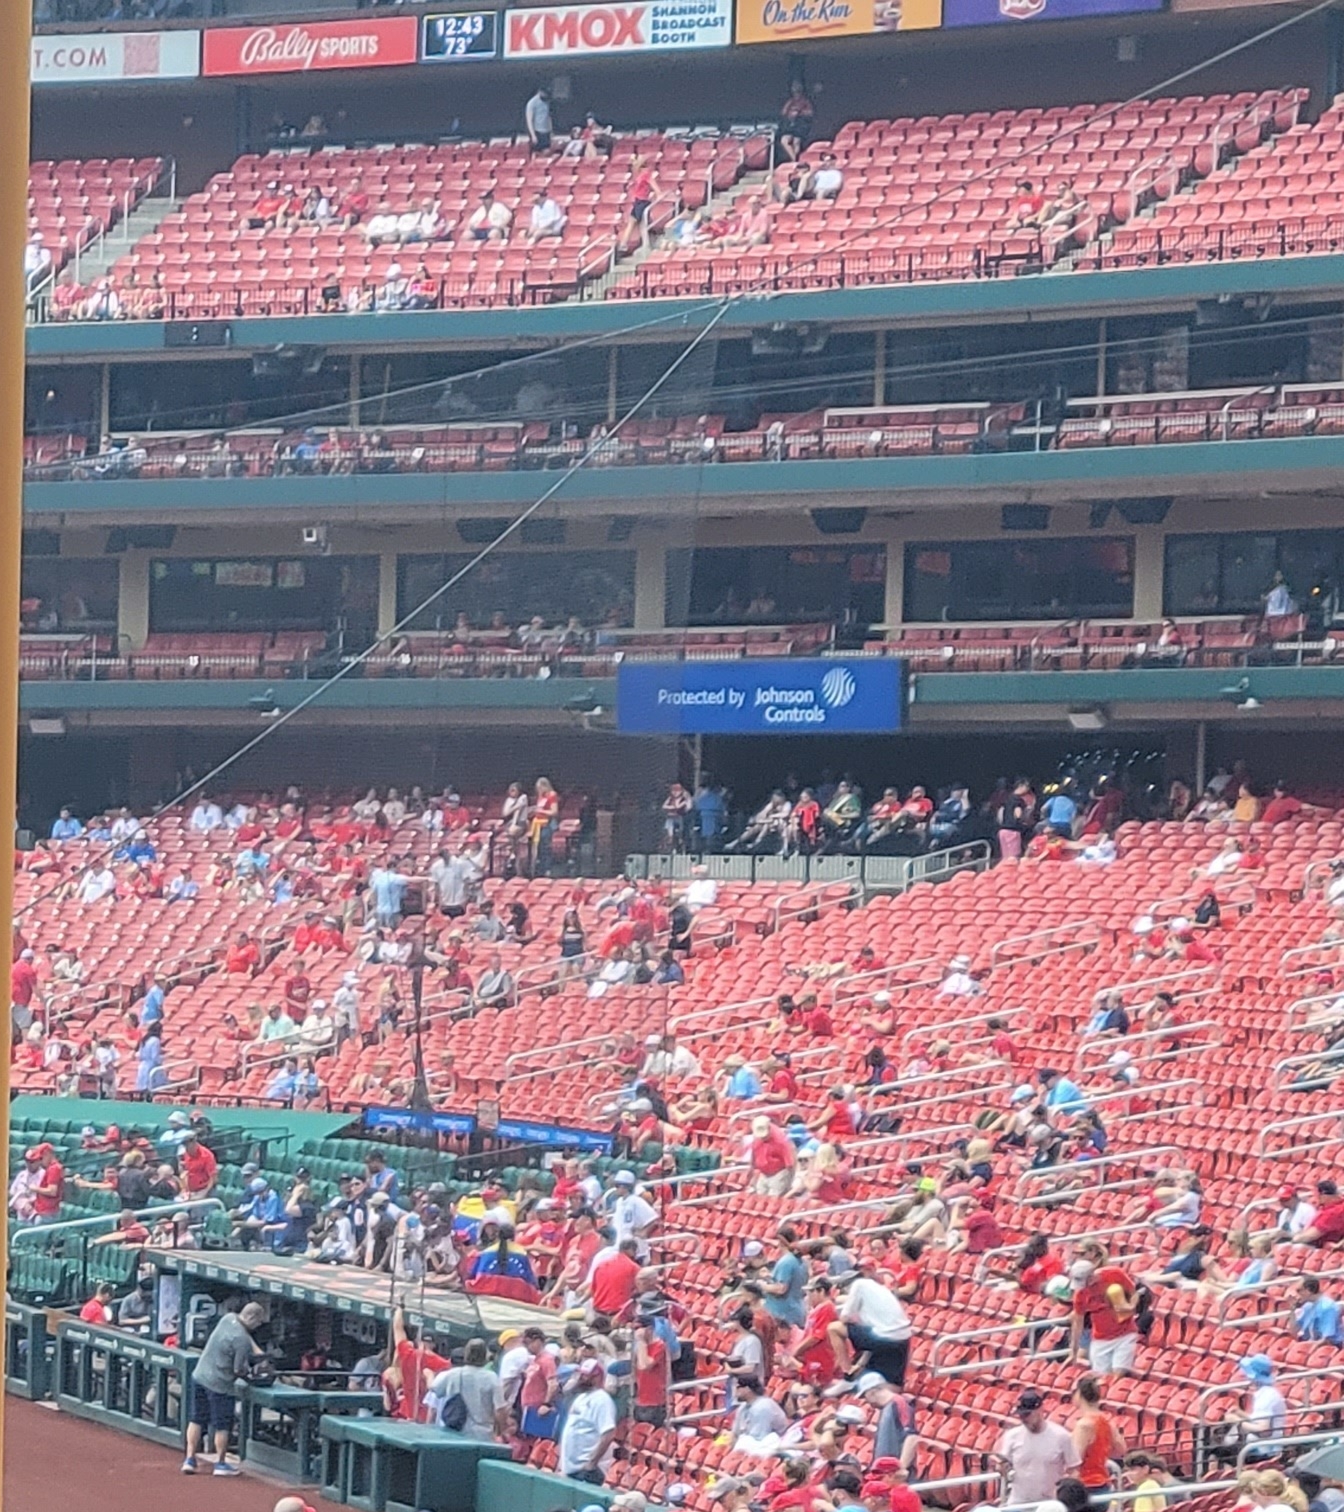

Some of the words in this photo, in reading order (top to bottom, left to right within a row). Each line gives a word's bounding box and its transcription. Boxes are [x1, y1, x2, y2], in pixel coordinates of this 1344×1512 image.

[436, 16, 484, 36] 12:43
[509, 7, 646, 51] KMOX
[651, 16, 727, 31] BROADCAST
[651, 31, 696, 44] BOOTH
[241, 27, 320, 69] Bally
[320, 35, 379, 58] SPORTS
[658, 687, 725, 705] Protected
[729, 687, 746, 708] by
[754, 686, 814, 707] Johnson
[765, 704, 826, 723] Controls
